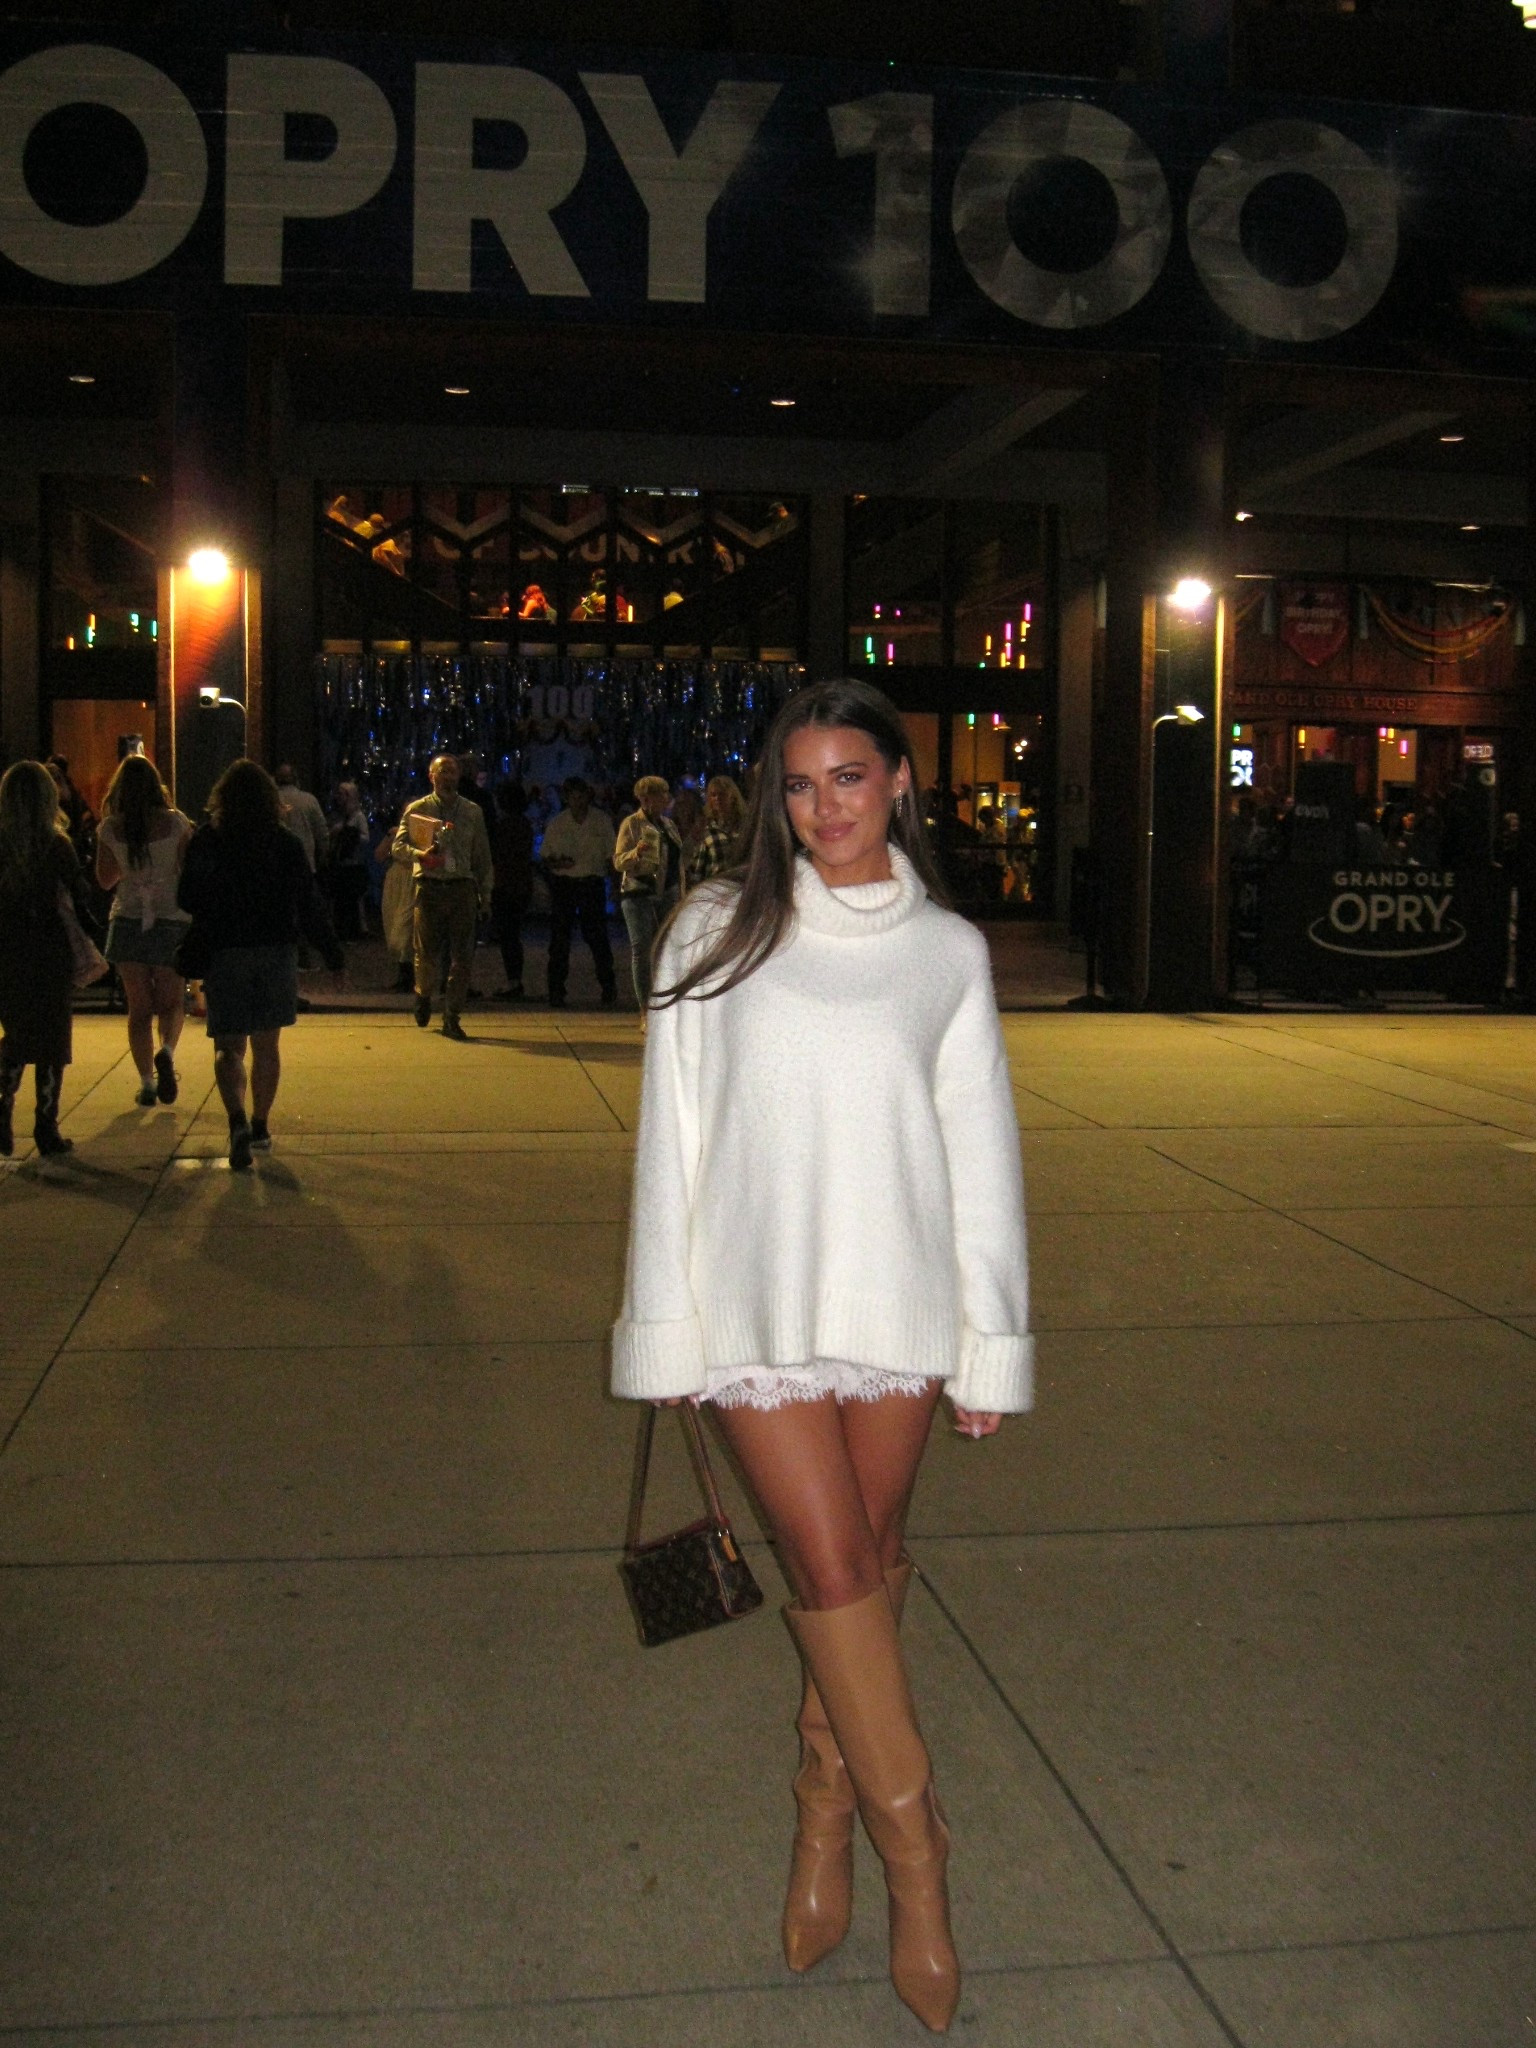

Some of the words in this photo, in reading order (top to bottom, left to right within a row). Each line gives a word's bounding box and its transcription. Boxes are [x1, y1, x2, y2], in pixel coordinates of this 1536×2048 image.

[0, 43, 784, 303] OPRY
[827, 92, 1399, 342] 100
[526, 685, 594, 719] 100
[1313, 694, 1357, 708] OPRY
[1363, 696, 1417, 710] HOUSE
[1334, 871, 1409, 887] GRAND
[1414, 872, 1456, 887] OLE
[1330, 892, 1453, 934] OPRY
